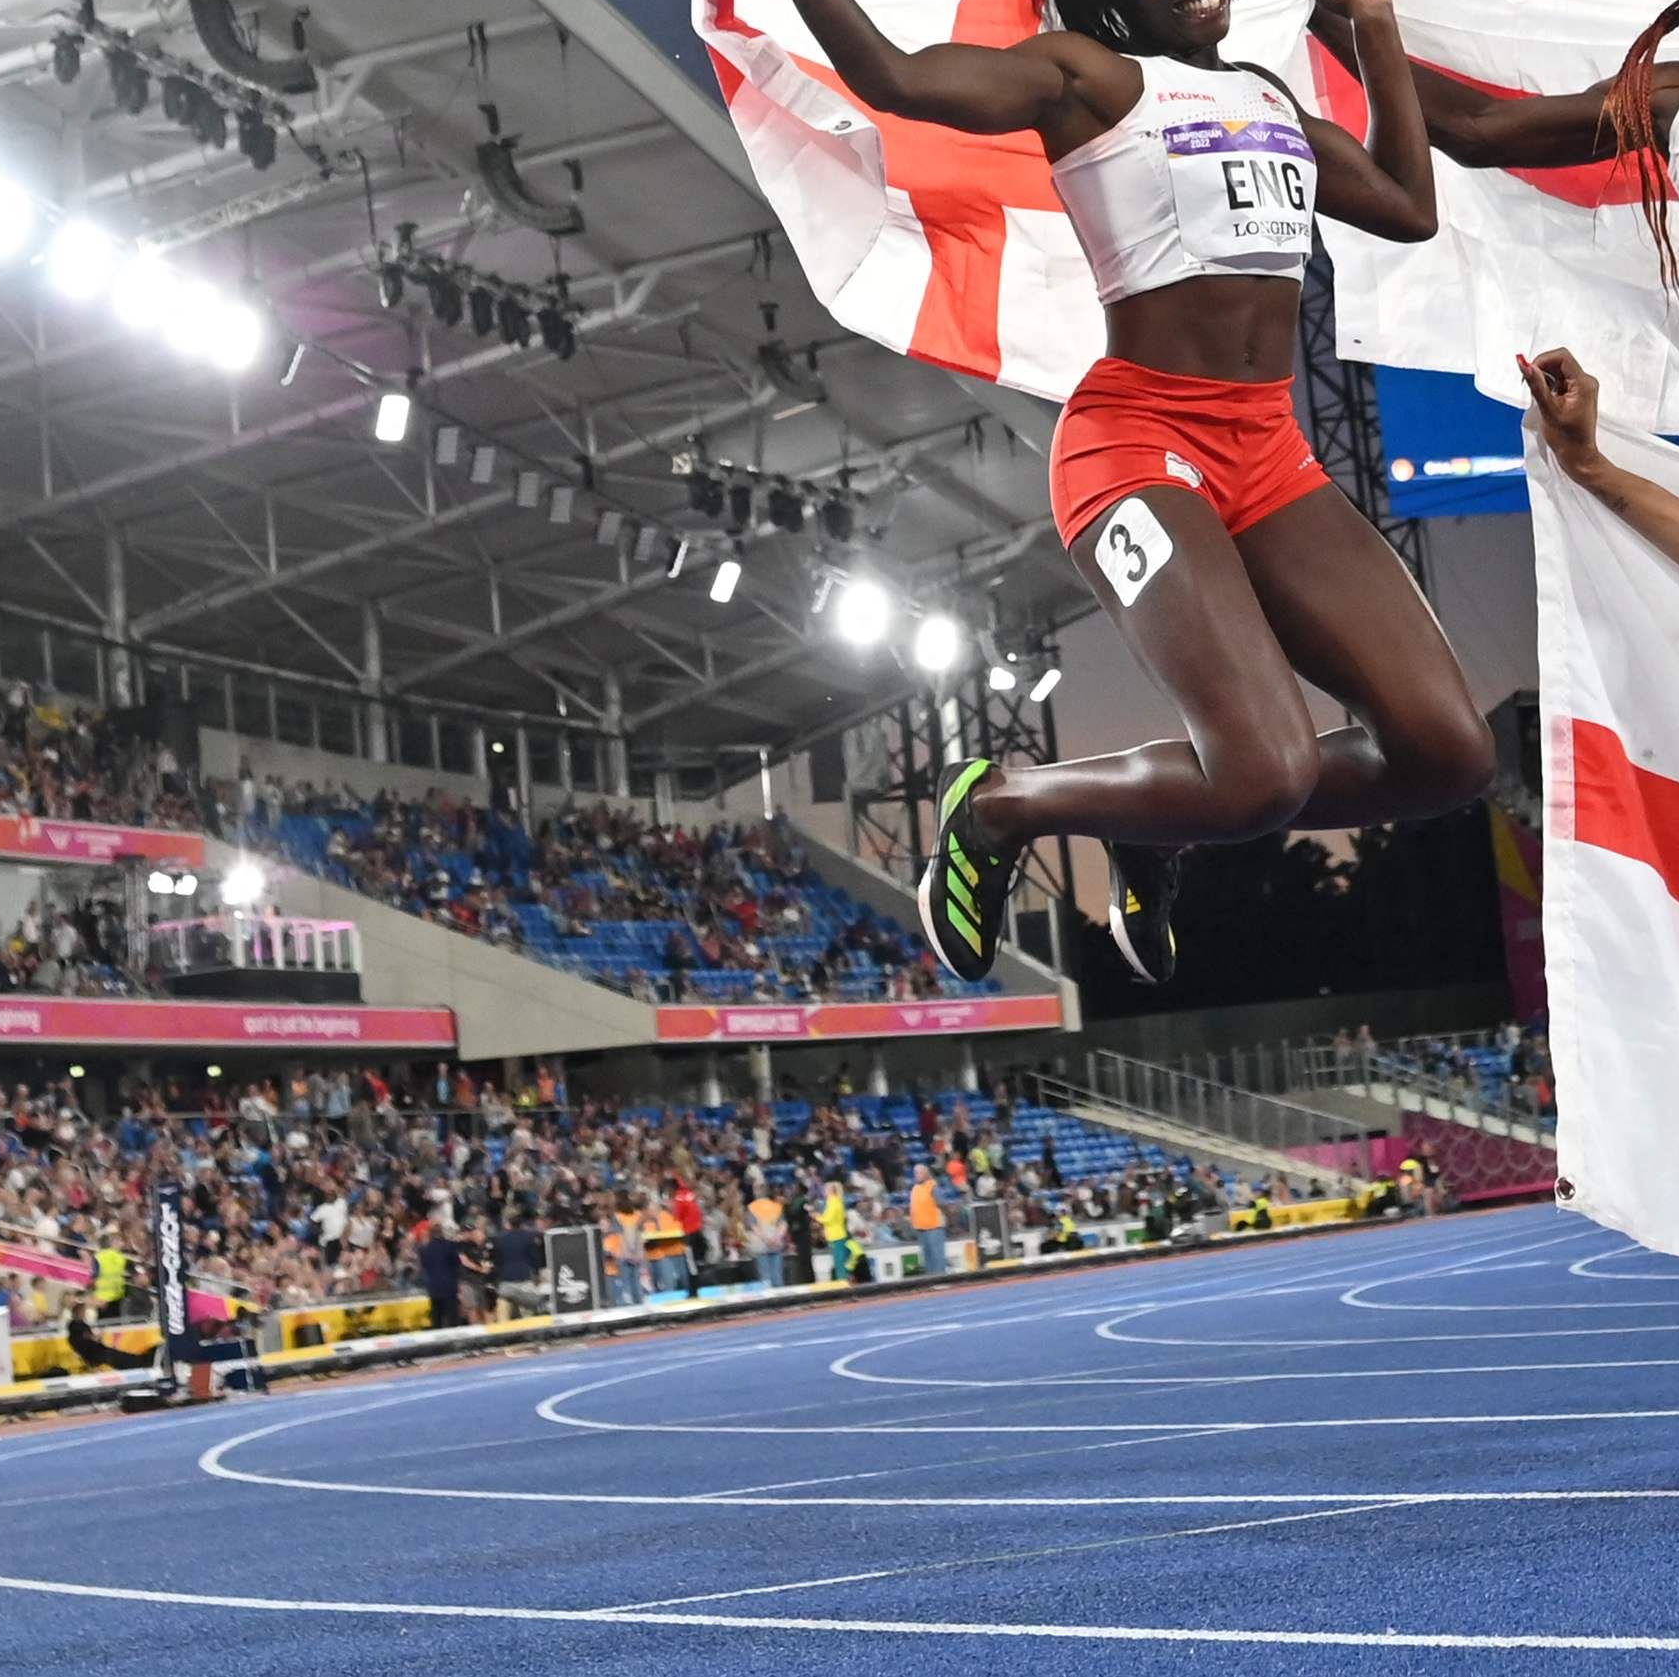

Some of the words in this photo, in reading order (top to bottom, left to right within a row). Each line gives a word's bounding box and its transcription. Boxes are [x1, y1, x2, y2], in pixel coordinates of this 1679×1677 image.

[1190, 138, 1211, 149] 2022
[1221, 160, 1307, 213] ENG
[1109, 524, 1148, 582] 3
[160, 1202, 186, 1335] LONGINES
